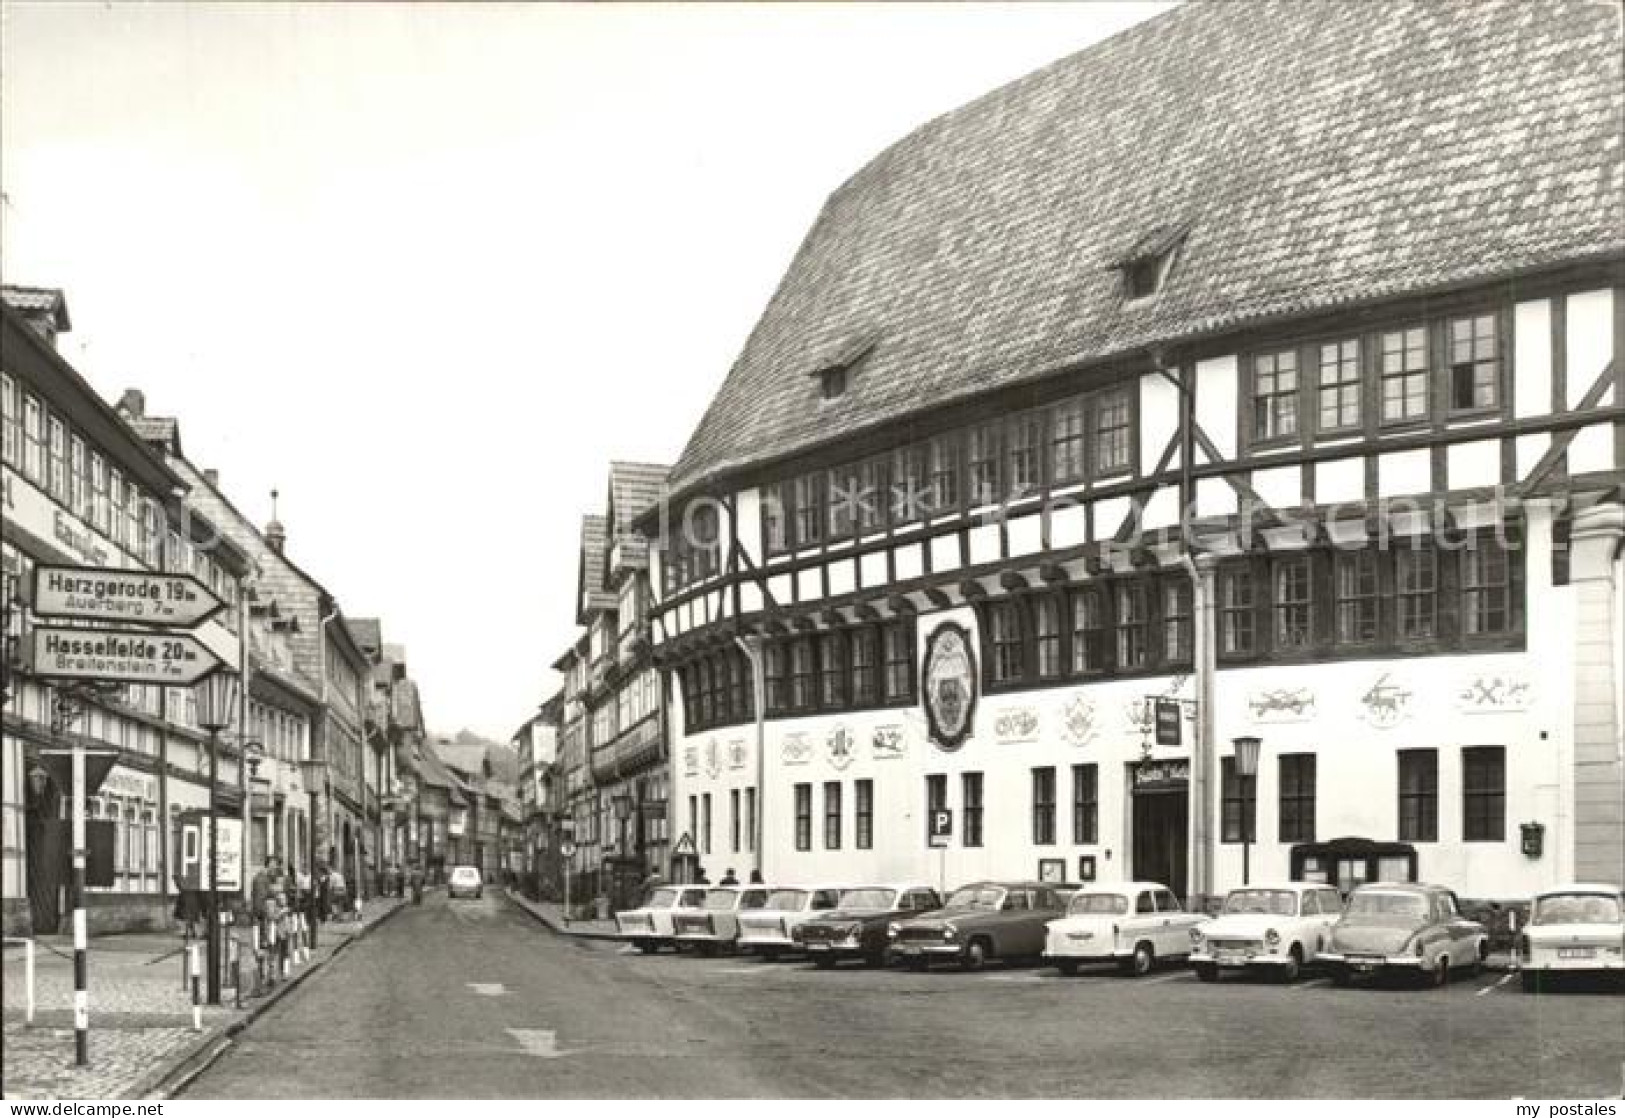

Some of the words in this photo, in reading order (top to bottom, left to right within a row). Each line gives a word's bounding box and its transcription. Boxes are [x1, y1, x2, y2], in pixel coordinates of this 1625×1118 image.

[49, 573, 161, 599] Harzgerode
[165, 581, 185, 601] 19
[65, 594, 144, 615] Auerberg
[154, 600, 163, 613] 7
[46, 635, 156, 659] Hasselfelde
[162, 641, 184, 660] 20
[56, 653, 156, 674] Breitenstein
[162, 662, 171, 673] 7
[937, 811, 948, 834] P
